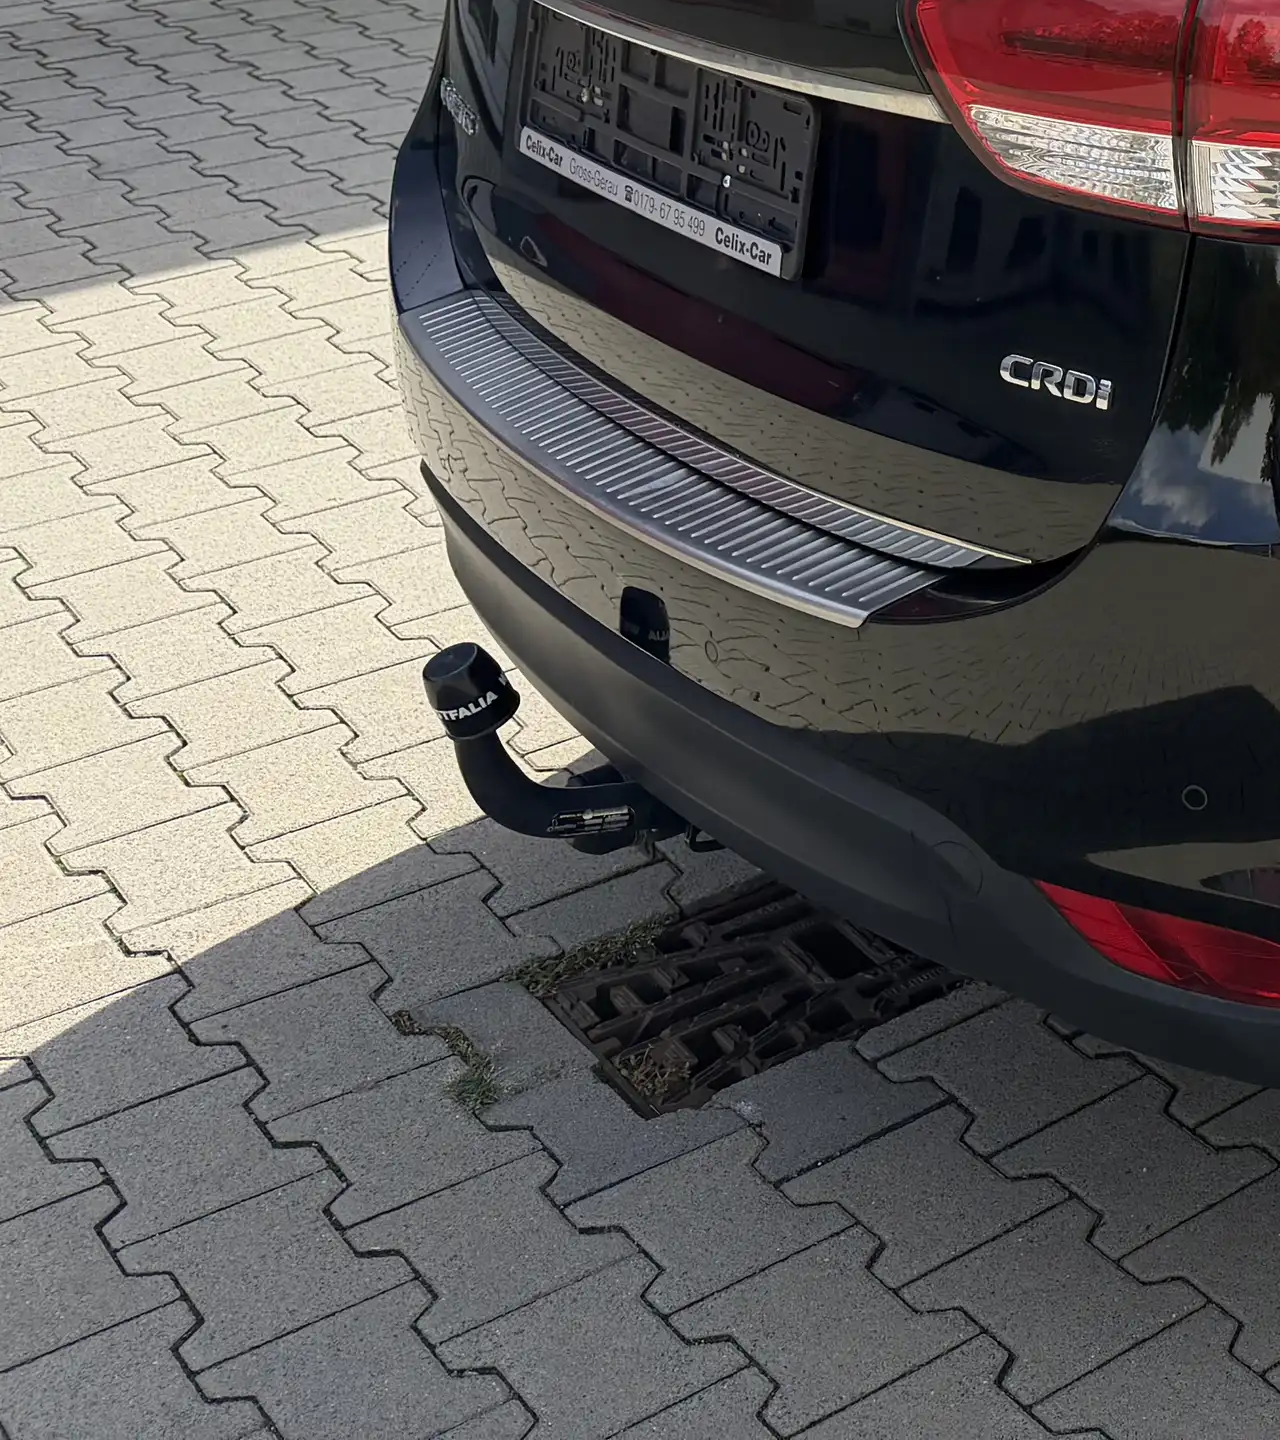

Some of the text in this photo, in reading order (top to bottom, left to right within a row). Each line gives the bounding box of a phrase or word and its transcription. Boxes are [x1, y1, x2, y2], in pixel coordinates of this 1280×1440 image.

[525, 134, 563, 168] Celix-Car
[569, 157, 619, 196] Gross-Gerau
[659, 201, 672, 220] 67
[673, 208, 686, 229] 95
[687, 215, 706, 237] 499
[715, 226, 772, 266] Celix-Car
[1000, 354, 1112, 410] CRDi
